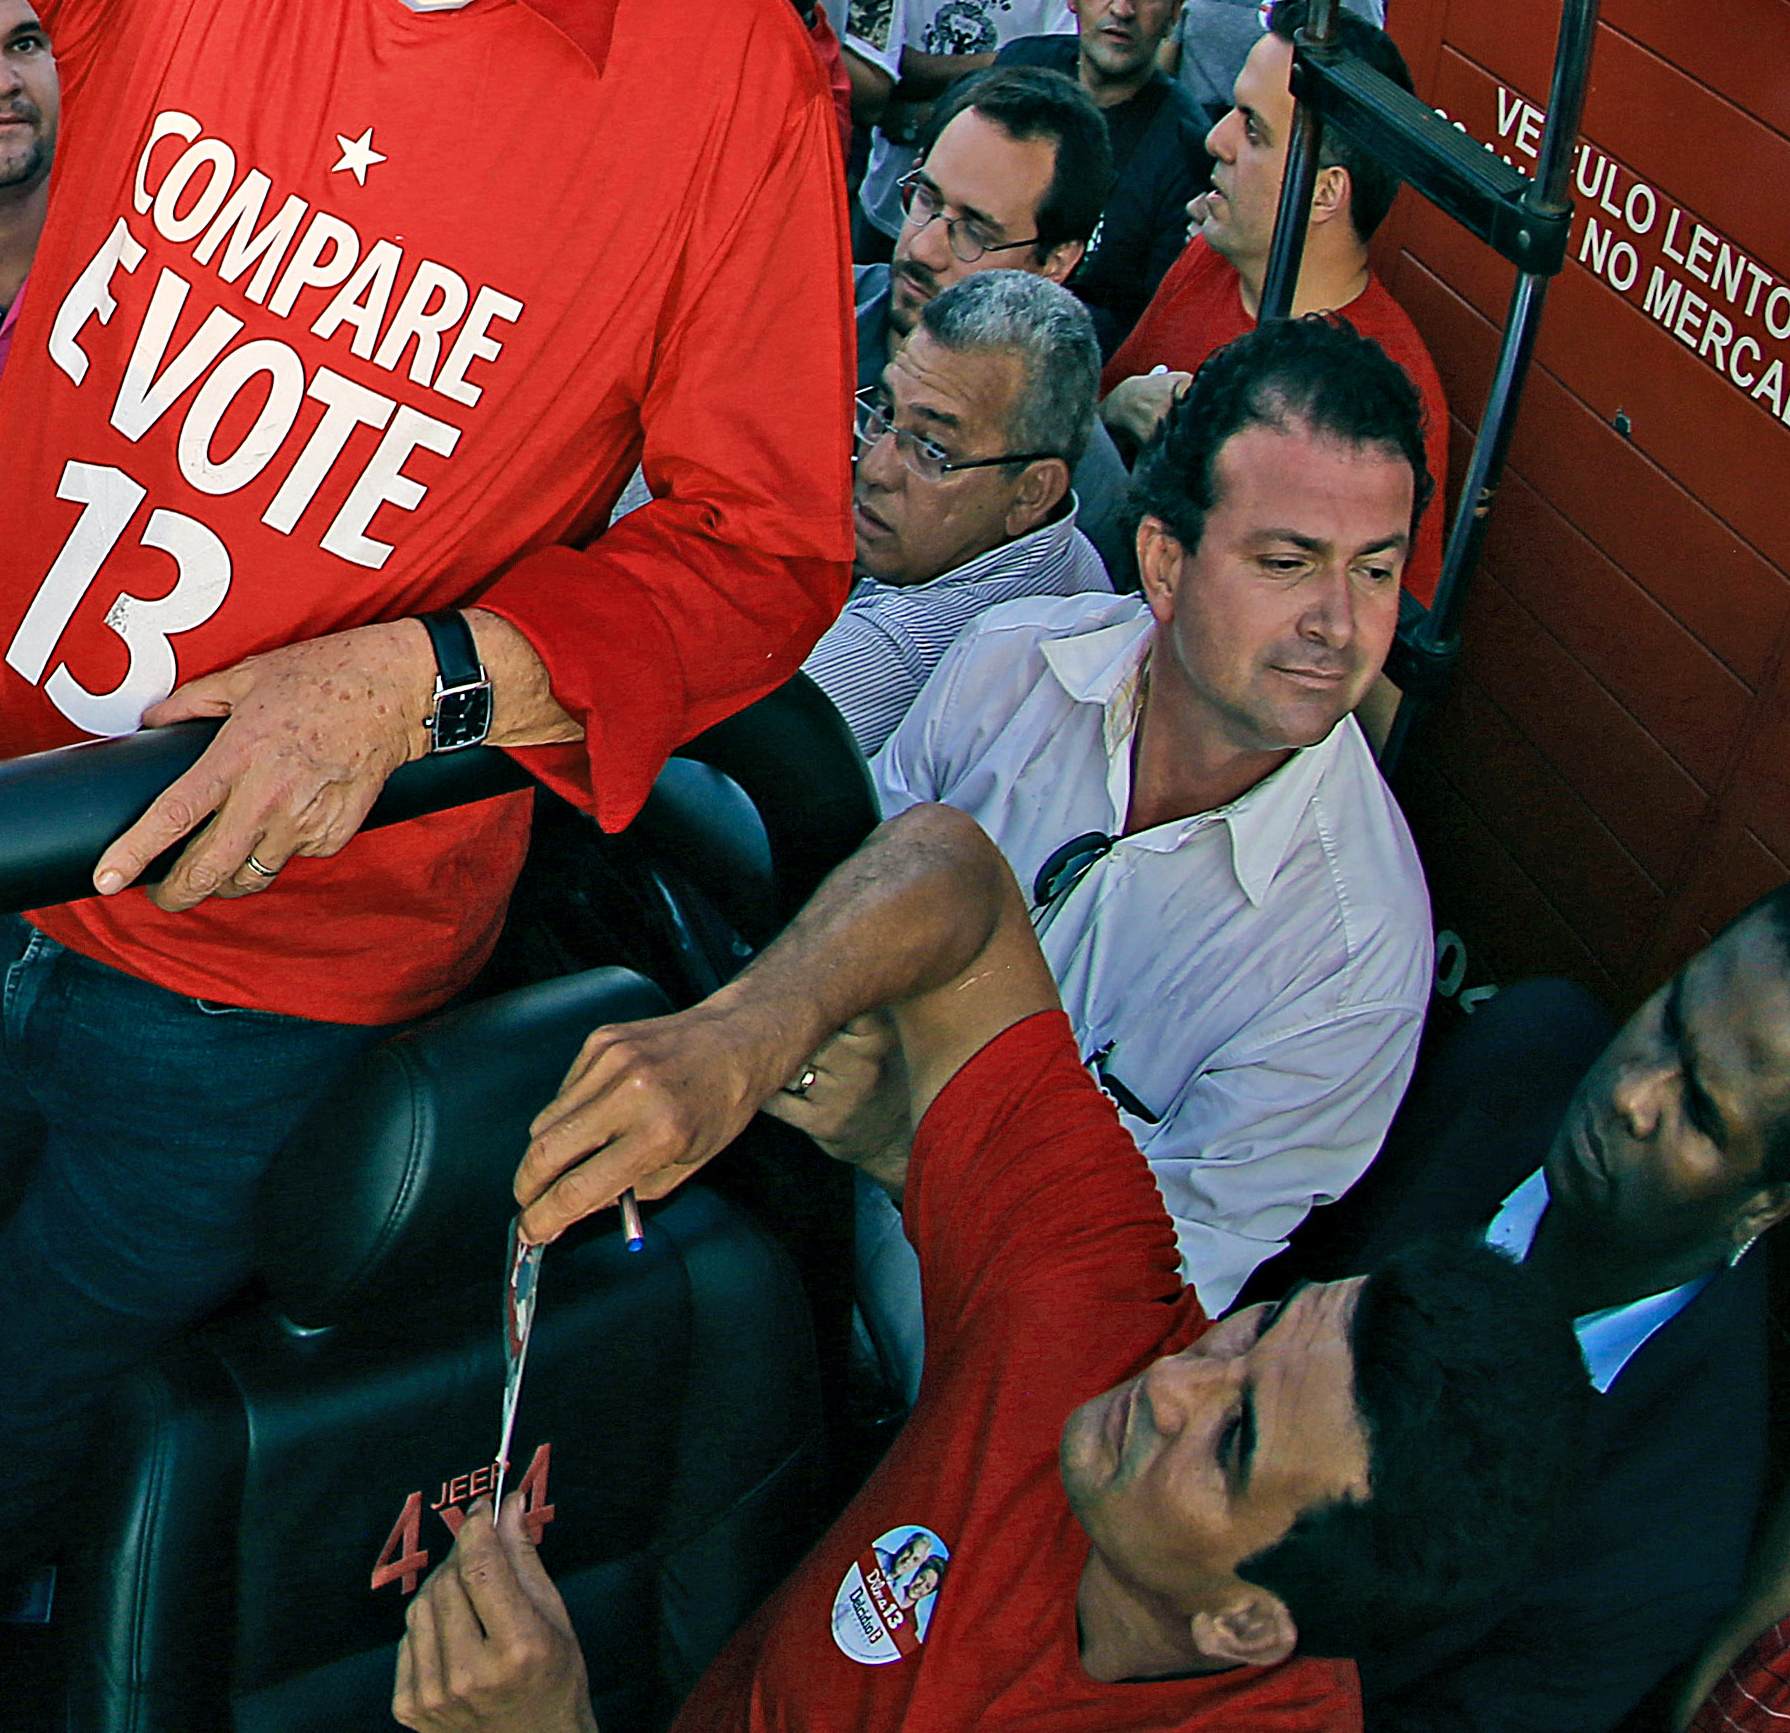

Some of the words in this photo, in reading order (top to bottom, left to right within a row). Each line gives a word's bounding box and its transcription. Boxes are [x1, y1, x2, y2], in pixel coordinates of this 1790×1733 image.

[131, 110, 524, 408] COMPARE
[1497, 86, 1657, 235] VEULO
[1661, 208, 1790, 340] LENTO
[1579, 217, 1639, 292] NO
[1643, 266, 1790, 427] MERCA
[48, 216, 146, 387] E
[110, 268, 461, 570] VOTE
[4, 459, 232, 739] 13
[371, 1442, 555, 1595] 44
[430, 1460, 511, 1511] JEEP
